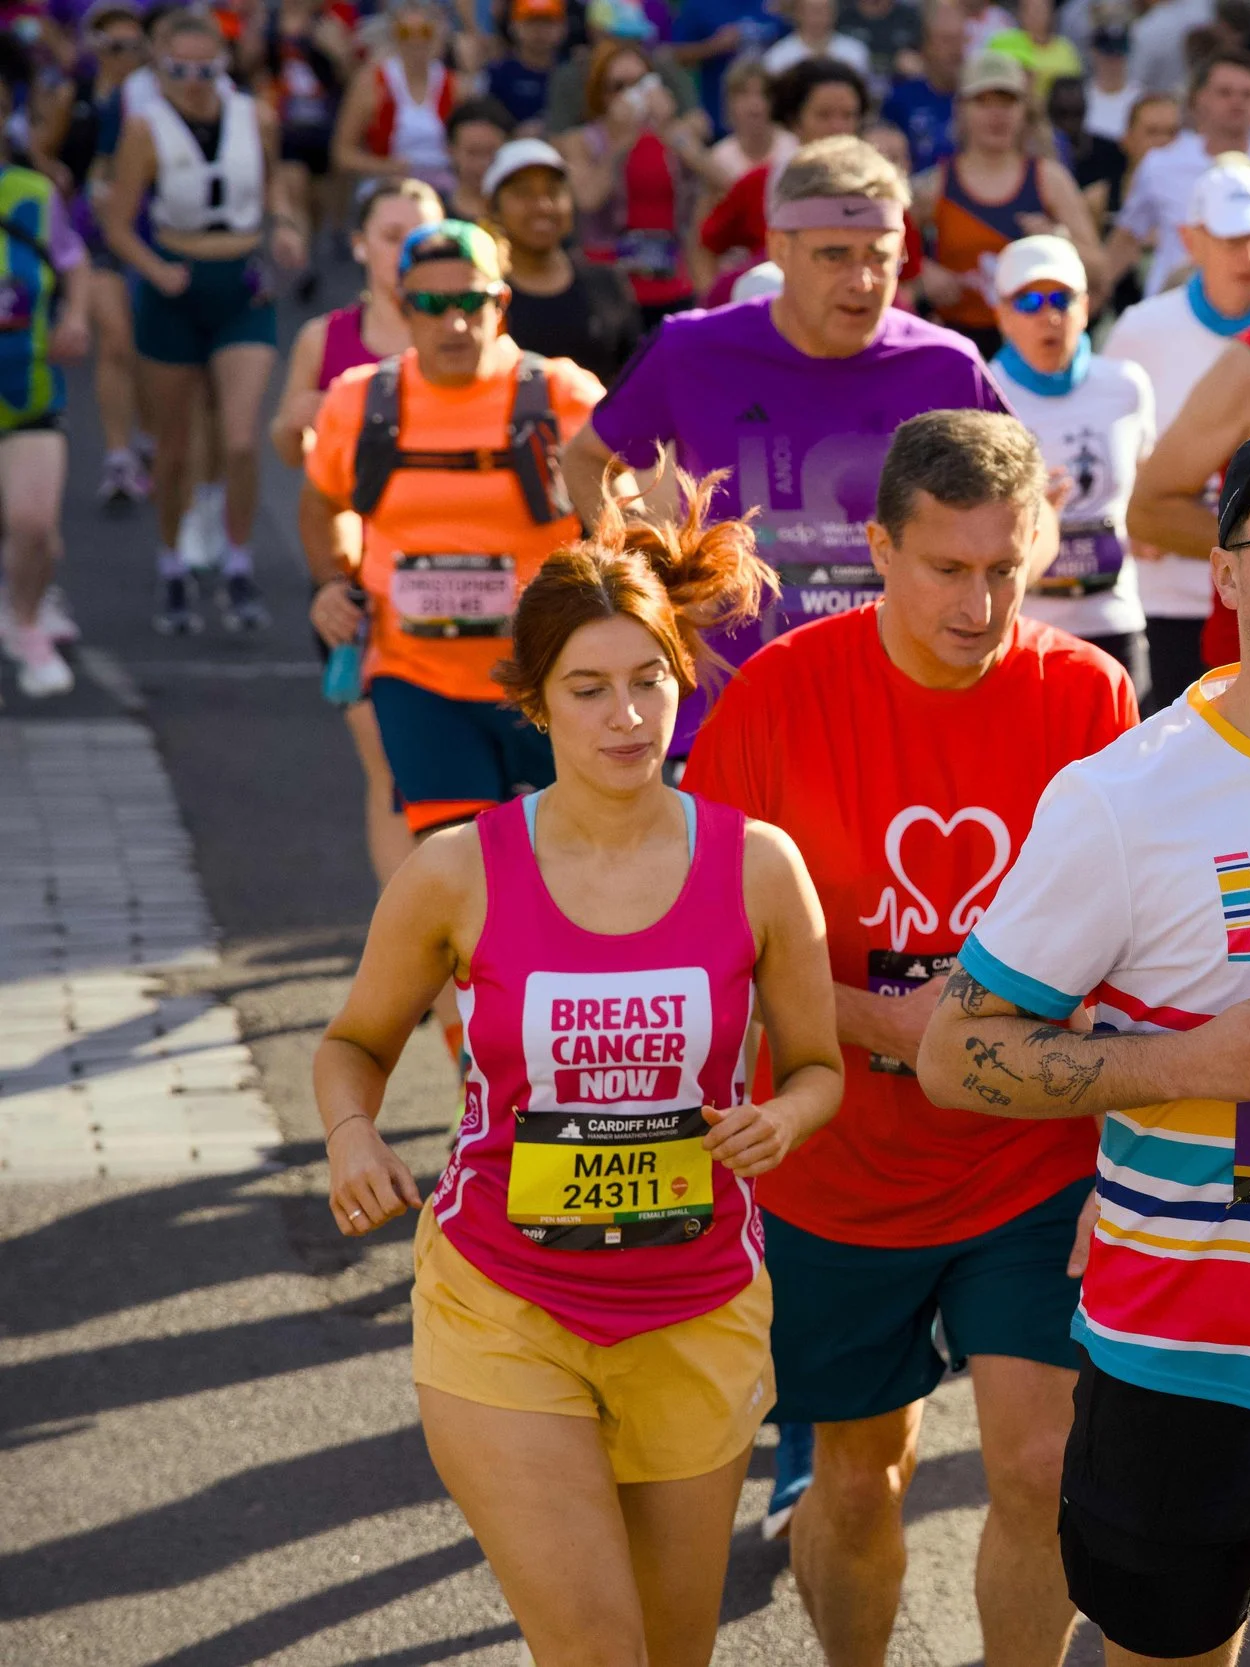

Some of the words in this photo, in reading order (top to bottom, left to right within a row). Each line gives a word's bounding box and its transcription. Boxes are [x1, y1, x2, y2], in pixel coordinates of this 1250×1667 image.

[551, 995, 686, 1032] BREAST
[552, 1033, 686, 1065] CANCER
[579, 1069, 660, 1100] NOW
[588, 1119, 644, 1132] CARDIFF
[646, 1116, 679, 1129] HALF
[574, 1151, 657, 1178] MAIR
[563, 1179, 659, 1209] 24311
[638, 1210, 666, 1220] FEMALE
